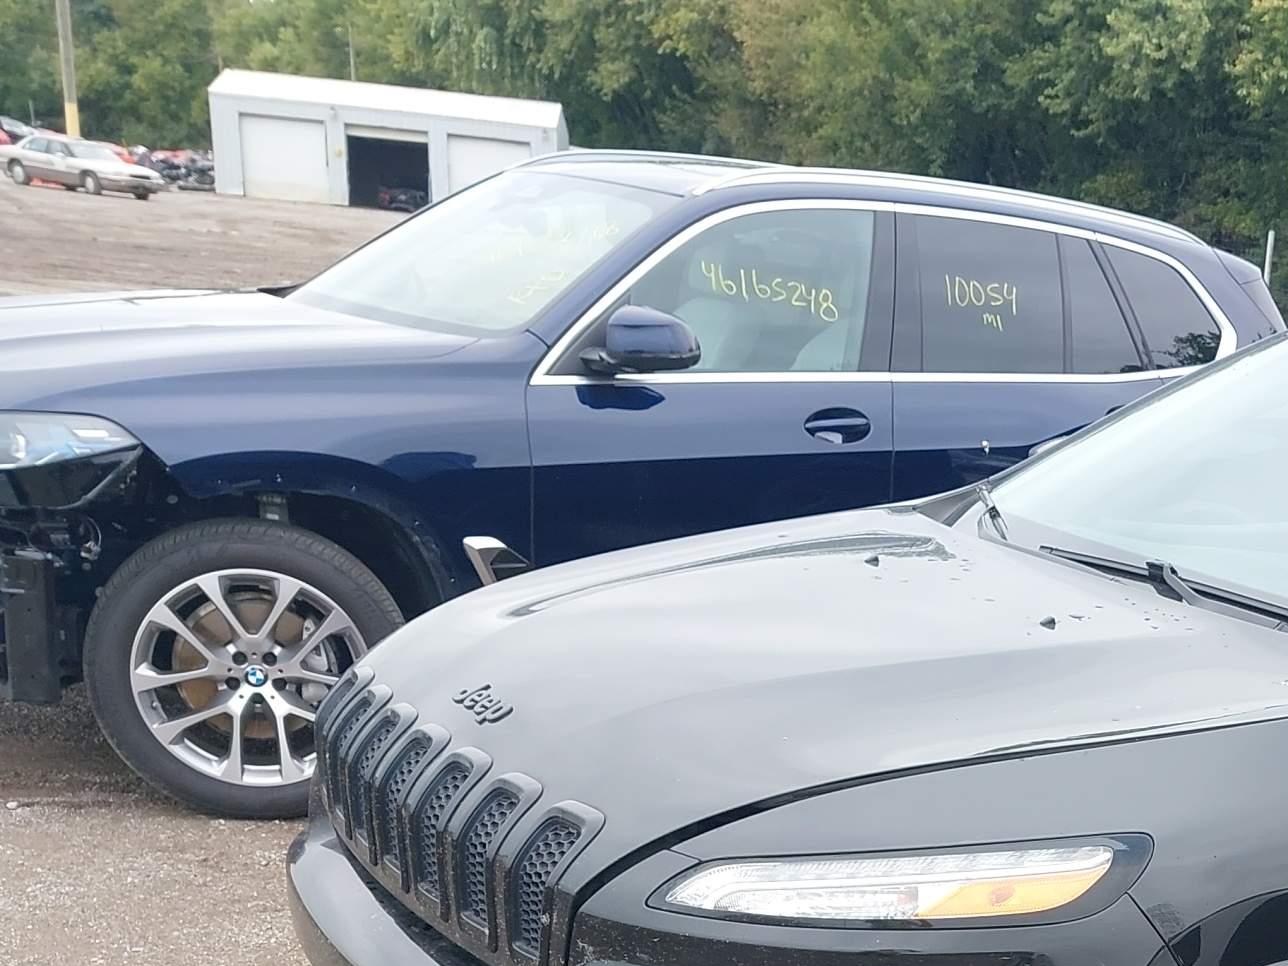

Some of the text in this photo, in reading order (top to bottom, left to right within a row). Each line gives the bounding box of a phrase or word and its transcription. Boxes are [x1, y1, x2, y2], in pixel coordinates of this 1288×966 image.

[700, 260, 839, 322] 46165248
[944, 272, 1017, 316] 10054
[451, 683, 514, 726] Jeep
